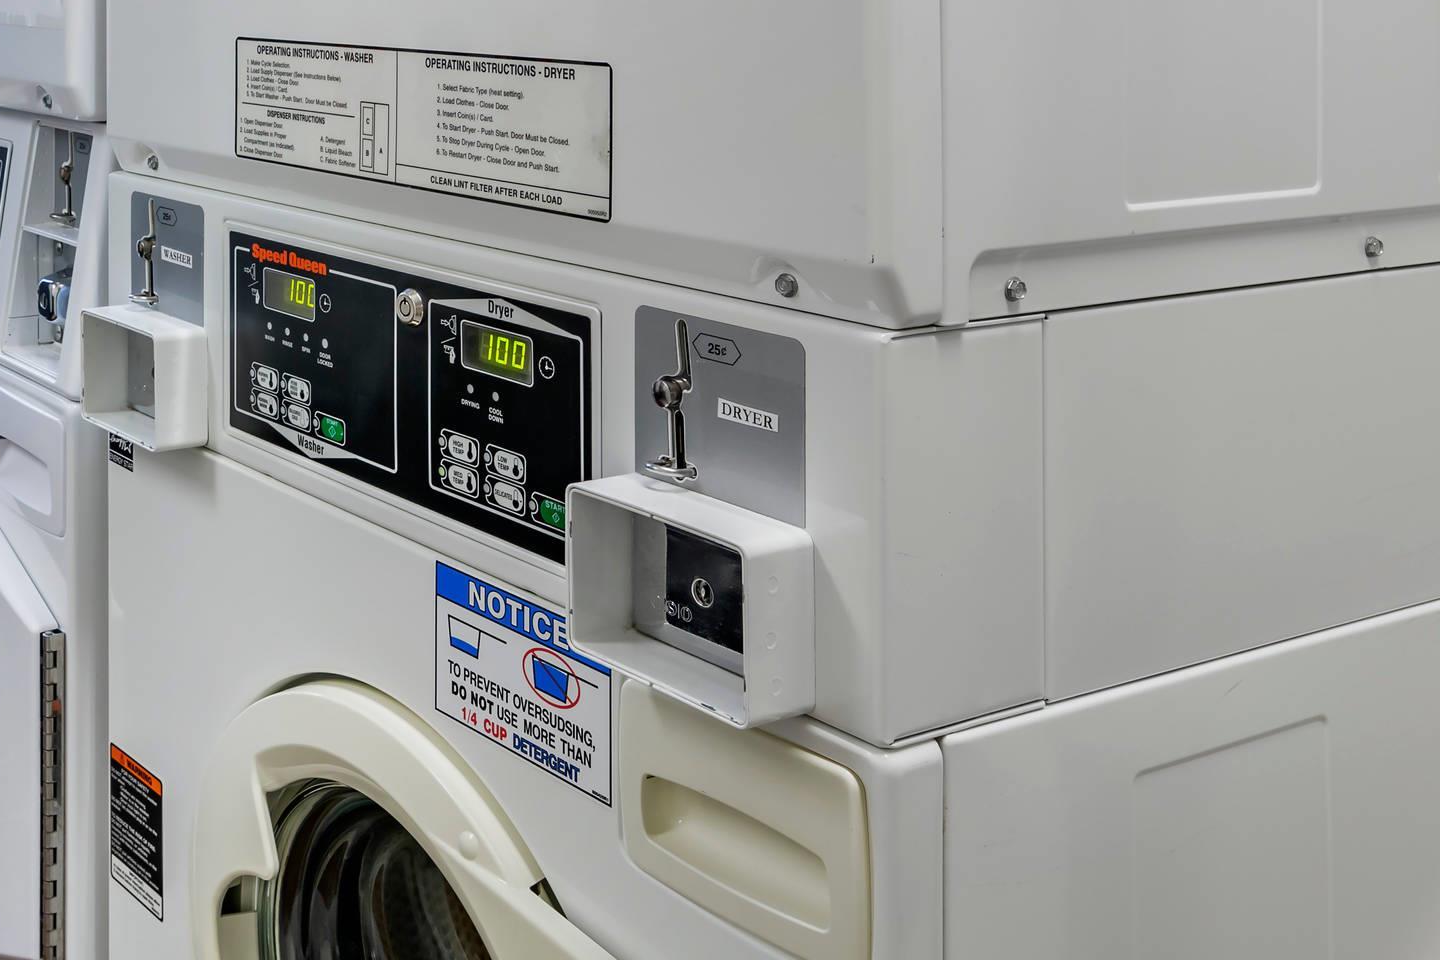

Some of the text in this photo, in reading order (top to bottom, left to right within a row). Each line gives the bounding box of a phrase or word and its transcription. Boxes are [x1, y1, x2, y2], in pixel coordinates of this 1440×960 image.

[257, 45, 373, 64] OPERATING INSTRUCTIONS WASHER
[274, 70, 292, 78] Dispenser
[304, 72, 326, 81] Instructions
[425, 58, 575, 80] OPERATING INSTRUCTIONS DRYER
[261, 76, 274, 84] Clothes
[443, 84, 458, 92] Select
[459, 86, 474, 94] Fabric
[475, 87, 487, 95] Type
[489, 88, 502, 97] (heat
[265, 93, 279, 101] Washer
[305, 97, 315, 105] Door
[316, 98, 326, 106] Must
[442, 97, 455, 105] Load
[456, 98, 474, 107] Clothes
[479, 101, 494, 109] Close
[267, 110, 325, 125] DISPENSER INSTRUCTIONS
[442, 110, 456, 118] Insert
[458, 112, 476, 120] Coin(s)
[254, 119, 273, 128] Dispenser
[254, 129, 269, 137] Supplies
[449, 124, 461, 132] Start
[462, 126, 476, 134] Dryer
[481, 128, 494, 136] Push
[511, 131, 524, 140] Door
[525, 133, 539, 142] Must
[325, 136, 346, 146] Detergent
[449, 137, 460, 146] Stop
[461, 139, 475, 148] Dryer
[477, 140, 494, 150] During
[495, 143, 510, 152] Cycle
[515, 145, 529, 155] Open
[244, 146, 272, 157] Close Dispenser
[325, 147, 352, 157] Liquid Bleach
[325, 157, 356, 168] Fabric Softener
[449, 150, 467, 160] Restart
[468, 153, 482, 162] Dryer
[486, 155, 501, 165] Close
[503, 158, 516, 167] Door
[517, 160, 527, 168] and
[529, 161, 543, 170] Push
[430, 175, 562, 205] CLEAN LINT FILTER AFTER EACH LOAD
[163, 249, 191, 265] WASHER
[252, 242, 327, 276] Speed Queen
[488, 300, 514, 319] Dryer
[319, 351, 331, 360] DOOR
[488, 334, 526, 370] 100
[708, 343, 727, 356] 25¢
[317, 358, 333, 368] LOCKED
[461, 398, 480, 409] DRYING
[489, 407, 503, 416] COOL
[721, 402, 774, 430] DRYER
[488, 414, 504, 424] DOWN
[298, 433, 324, 455] Washer
[453, 440, 463, 448] HIGH
[498, 456, 507, 464] LOW
[498, 462, 509, 471] TEMP
[454, 470, 463, 478] MED
[453, 477, 464, 485] TEMP
[468, 580, 570, 651] NOTICE
[448, 659, 596, 752] TO PREVENT OVERSUDSING,
[451, 681, 592, 768] DO NOT USE MORE THAN
[461, 707, 580, 783] 1/4 CUP DETERGENT
[127, 759, 152, 786] WARNING
